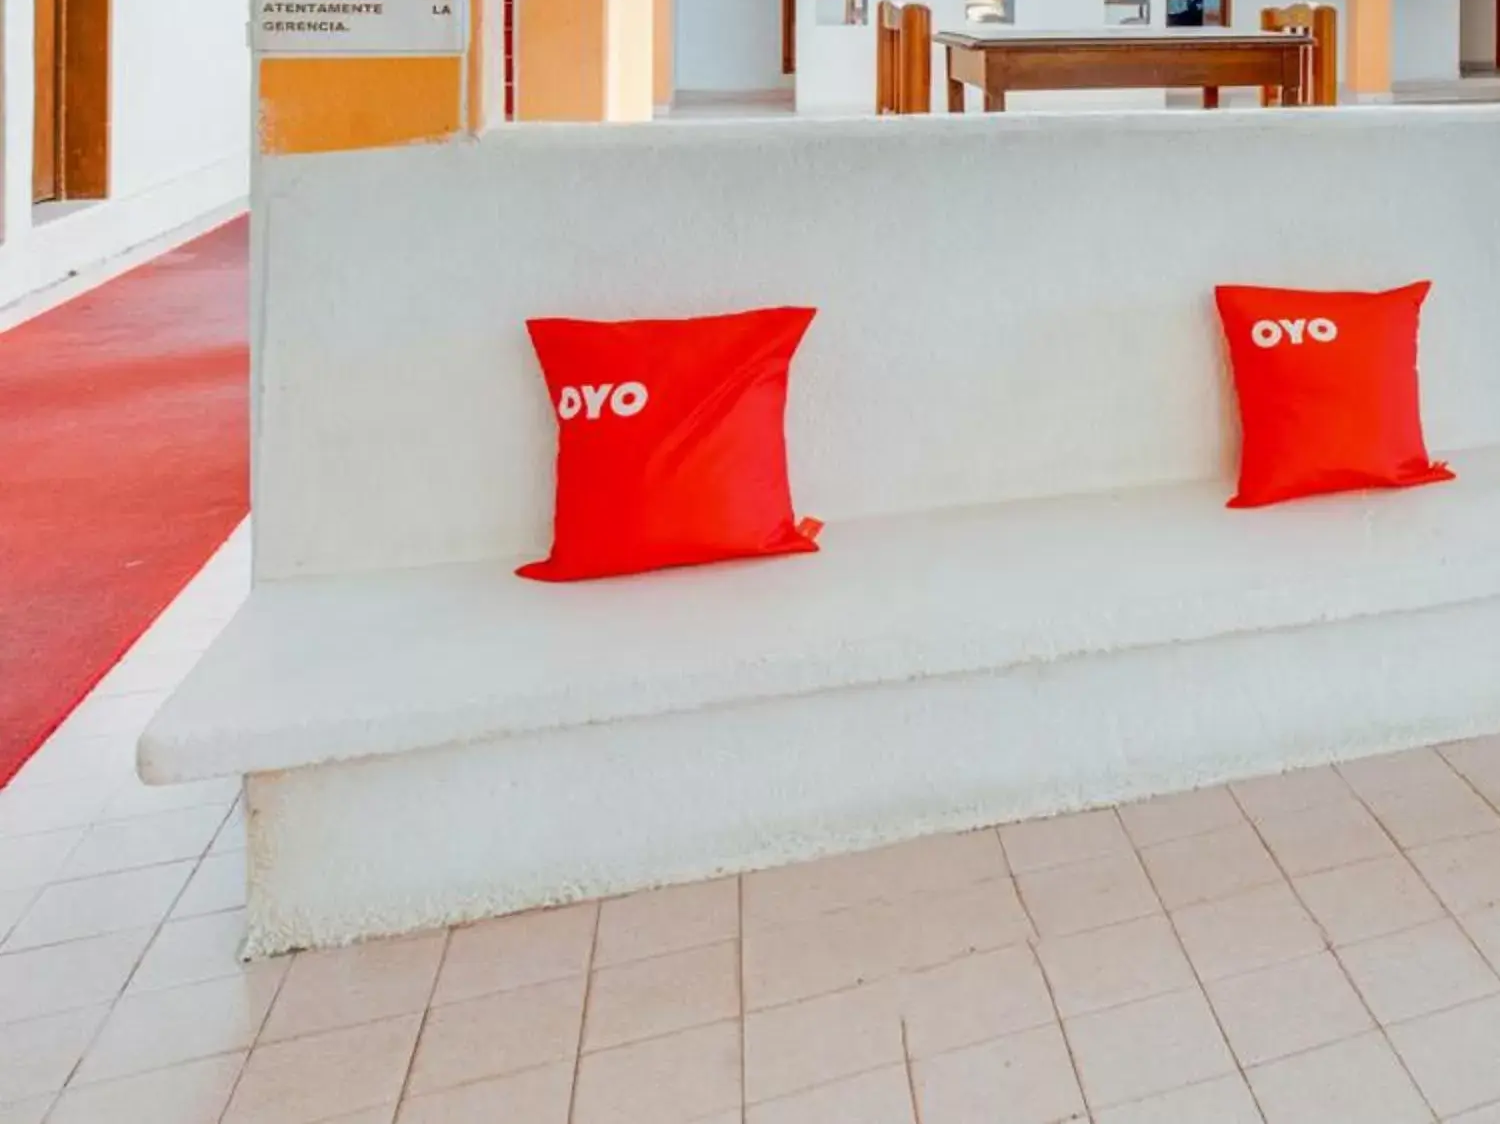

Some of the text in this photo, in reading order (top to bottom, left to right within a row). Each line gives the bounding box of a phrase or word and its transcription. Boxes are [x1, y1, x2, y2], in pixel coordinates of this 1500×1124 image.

[263, 2, 451, 15] ATENTAMENTE LA
[263, 21, 350, 32] GERENCIA.
[1251, 317, 1338, 348] OYO
